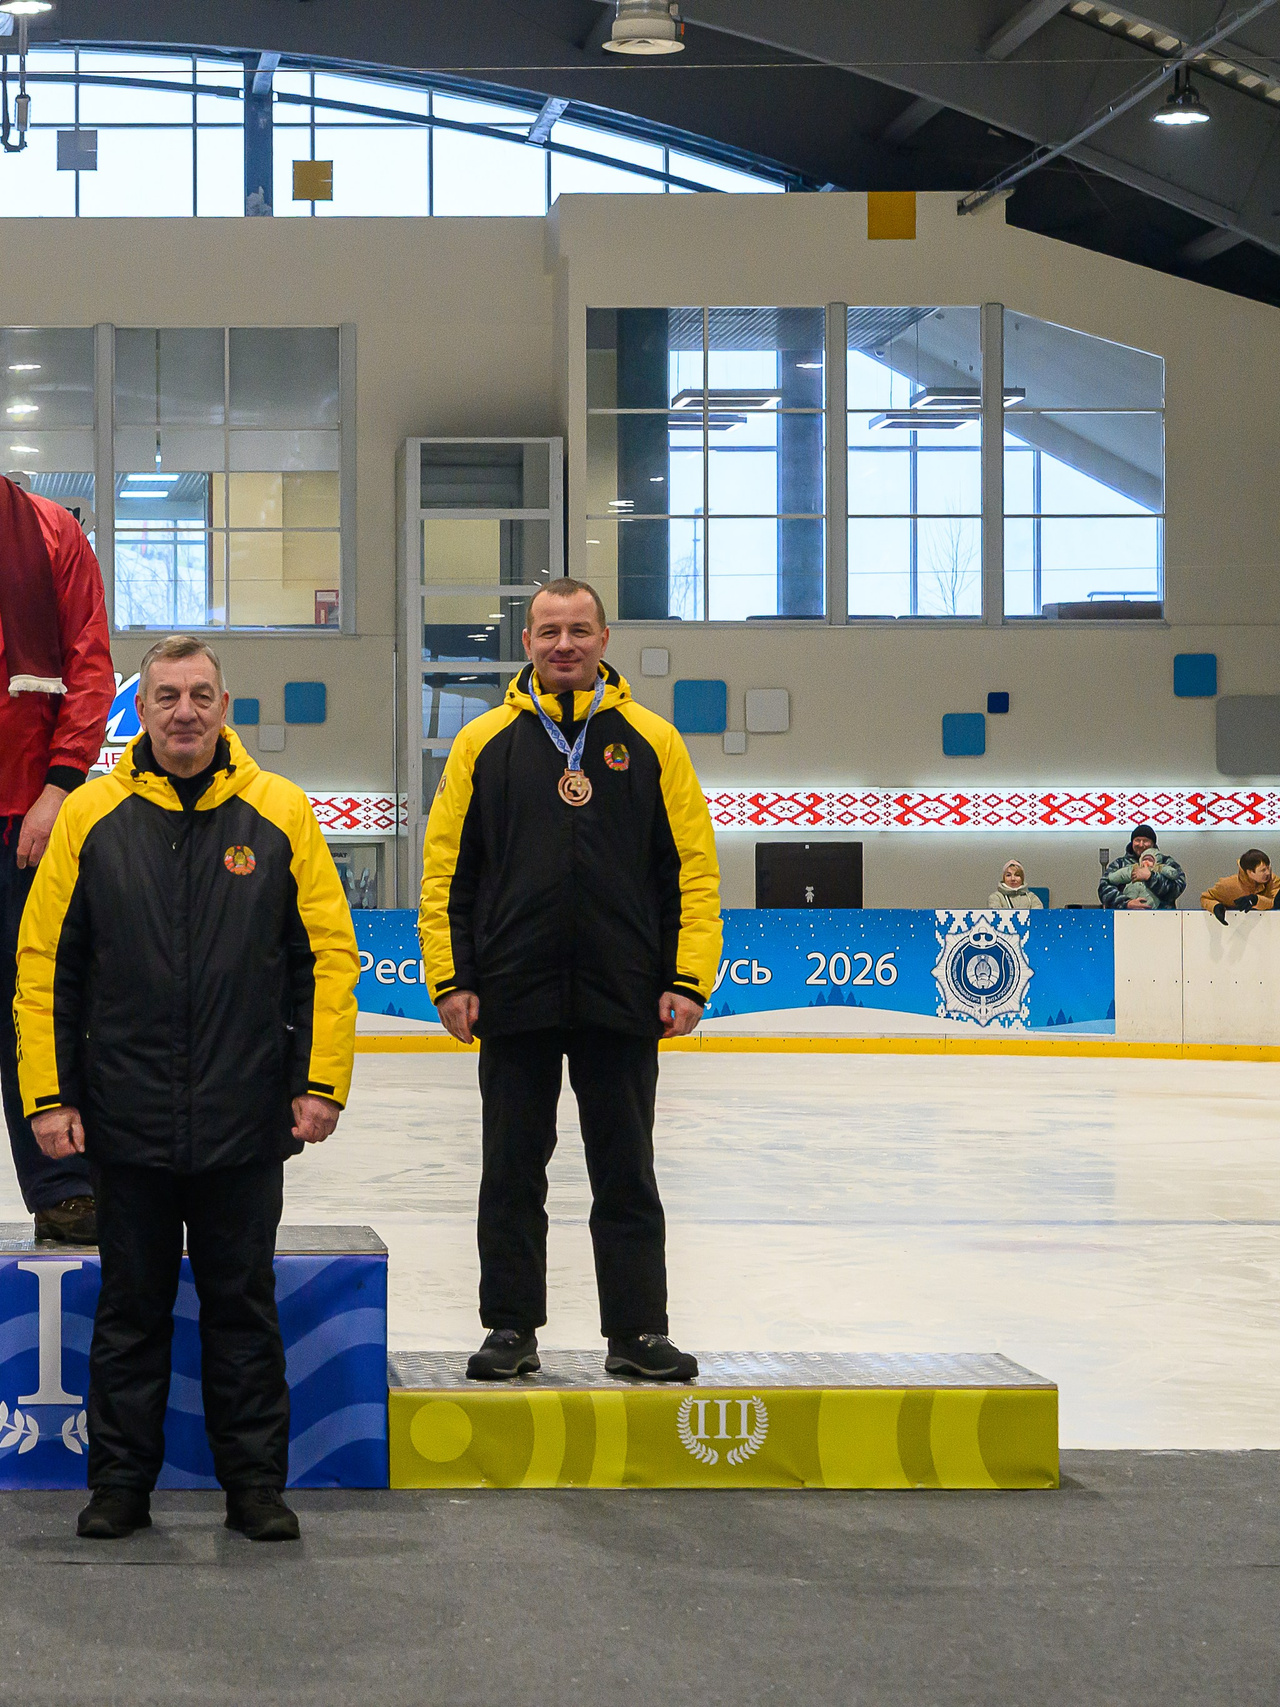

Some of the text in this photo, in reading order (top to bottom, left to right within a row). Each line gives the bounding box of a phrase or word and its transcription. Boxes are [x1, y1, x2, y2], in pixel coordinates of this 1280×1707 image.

[805, 952, 898, 986] 2026
[18, 1261, 83, 1404] I
[692, 1400, 755, 1439] III
